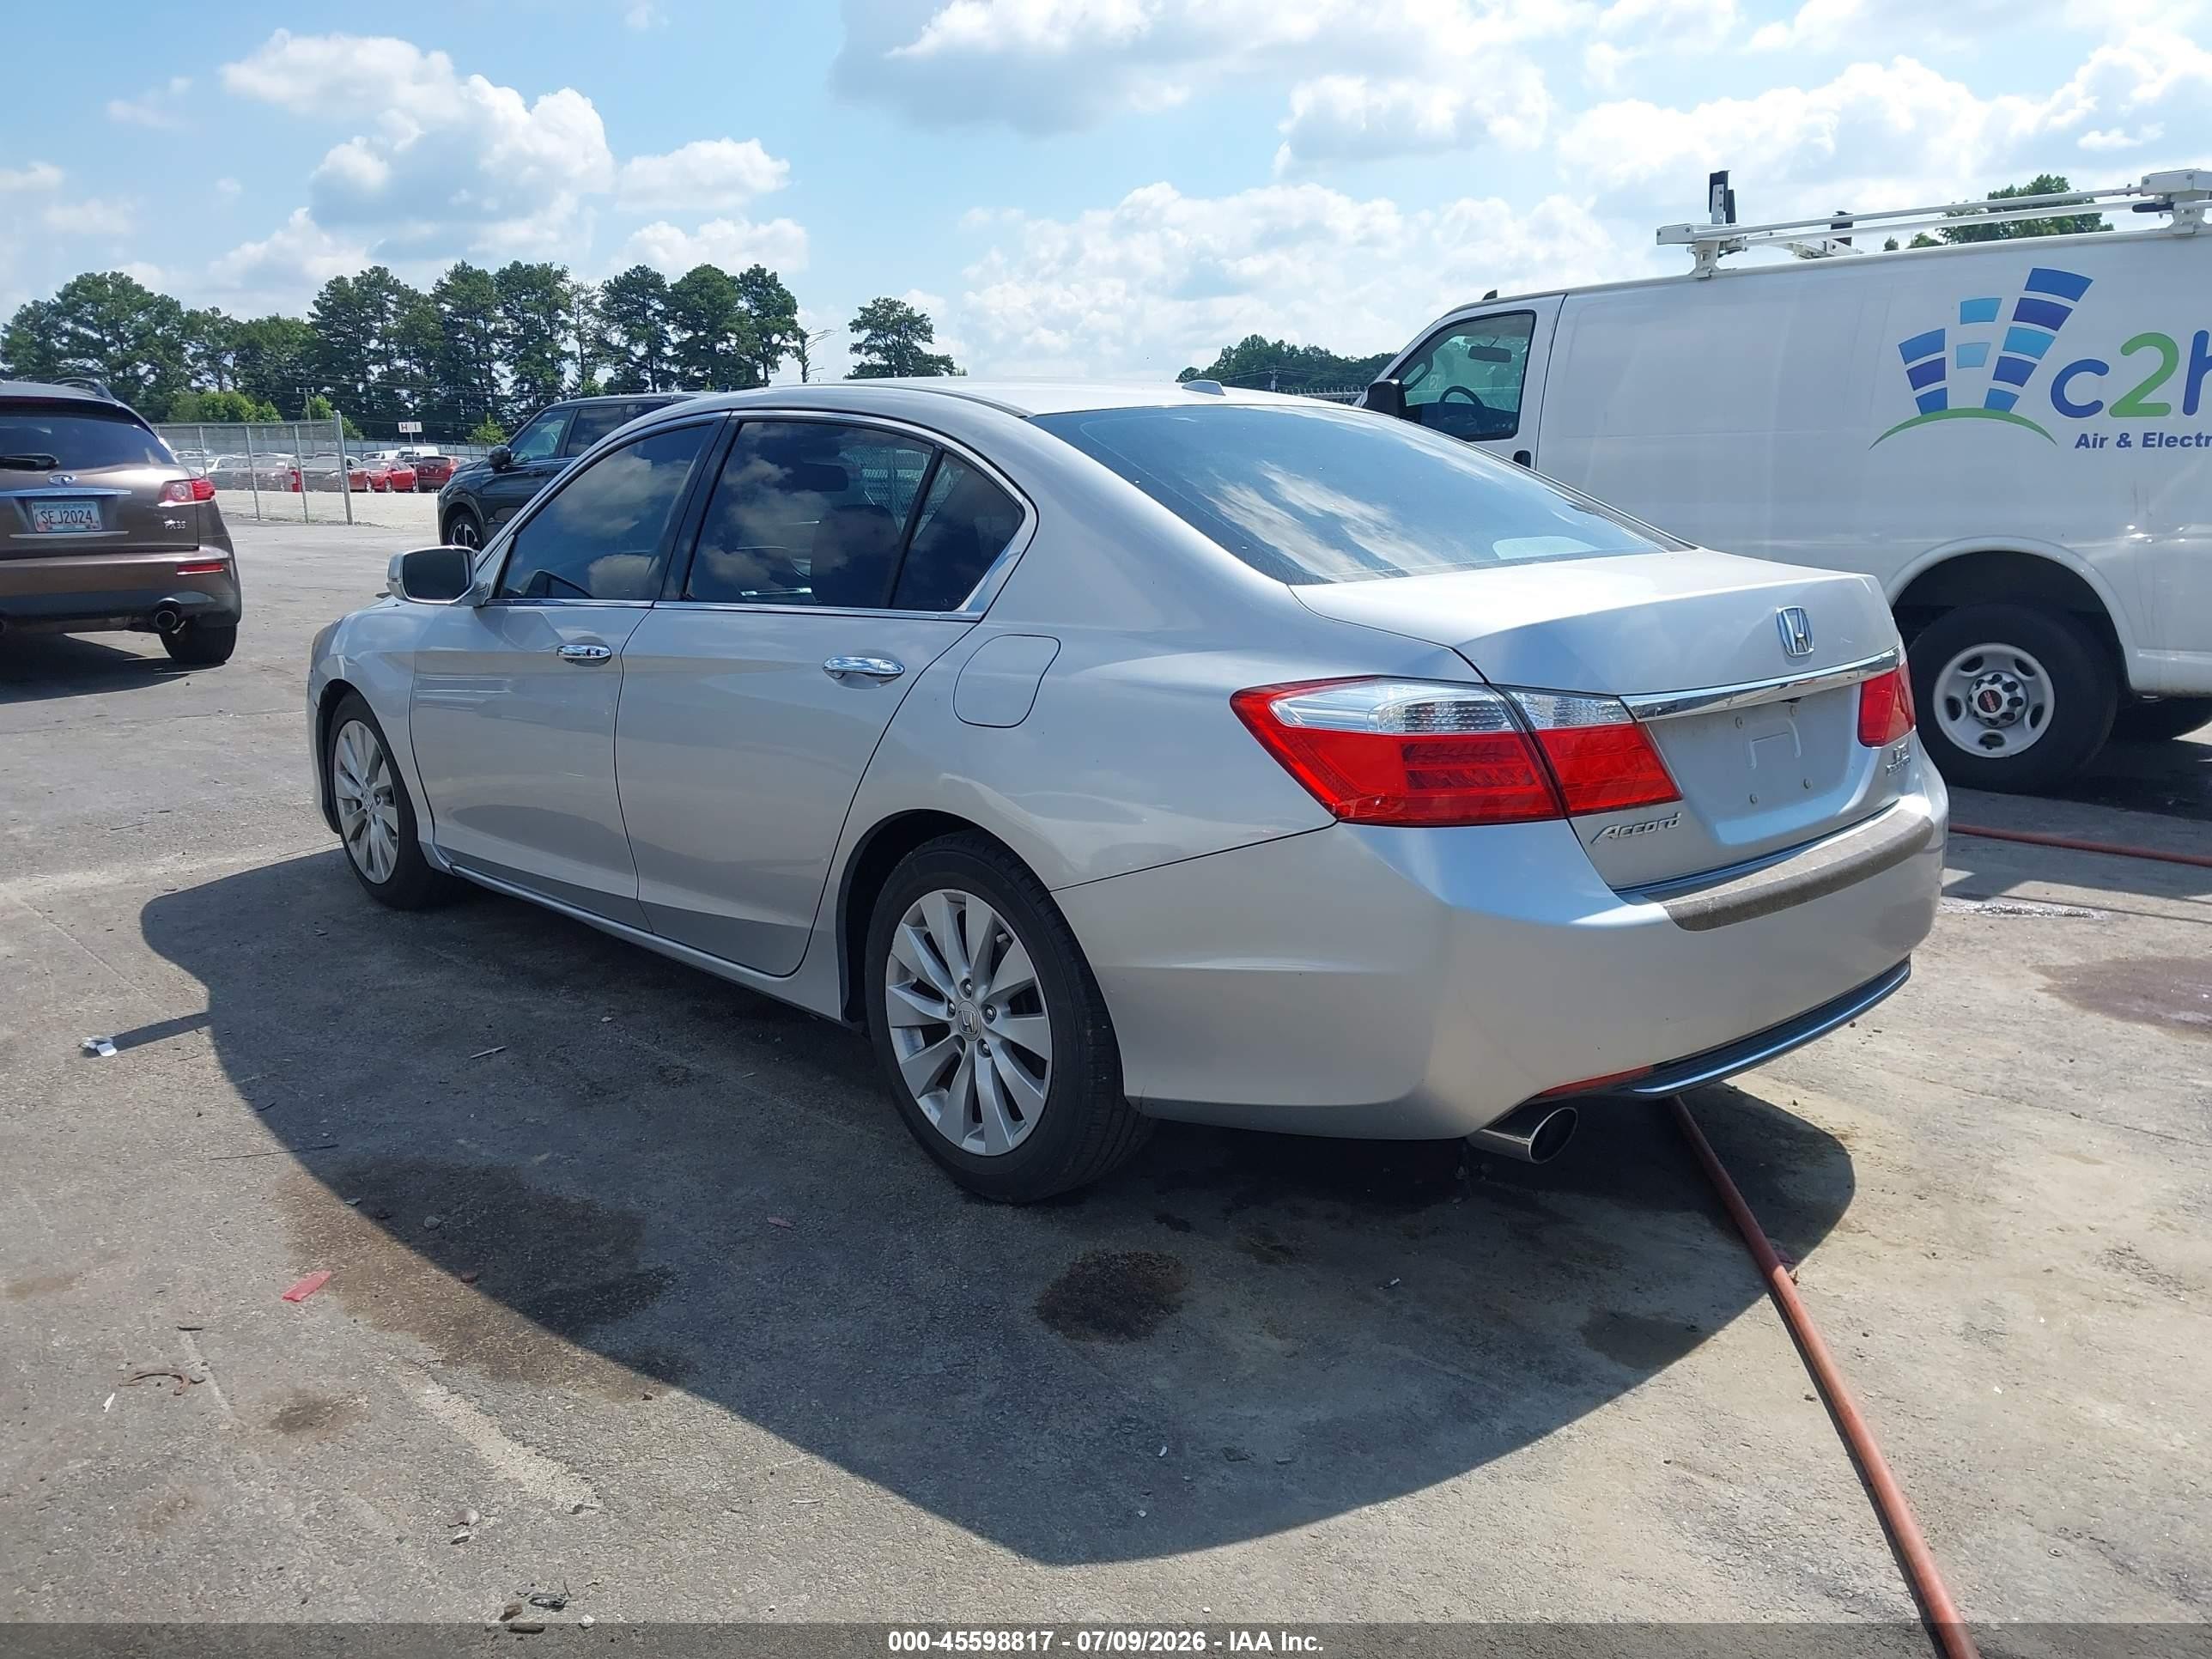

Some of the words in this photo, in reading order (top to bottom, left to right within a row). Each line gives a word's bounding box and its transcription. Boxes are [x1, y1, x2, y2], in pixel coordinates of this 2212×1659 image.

[2075, 433, 2108, 448] Air
[2116, 433, 2132, 448] &
[40, 509, 94, 525] SEJ2024
[1589, 811, 1682, 845] Accord
